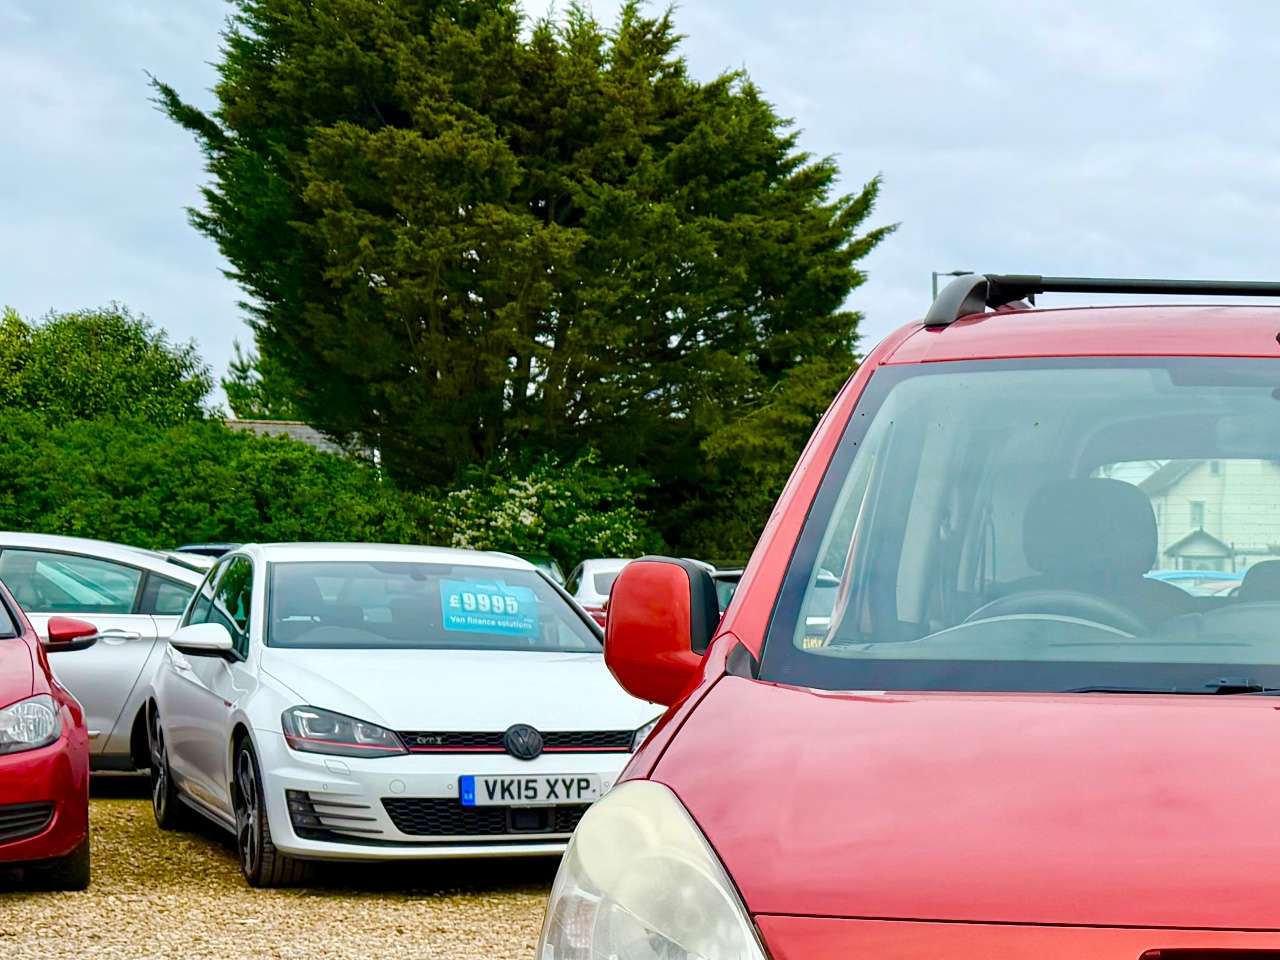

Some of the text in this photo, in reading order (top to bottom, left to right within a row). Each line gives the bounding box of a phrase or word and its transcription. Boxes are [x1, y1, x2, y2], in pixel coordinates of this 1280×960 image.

[450, 615, 532, 629] Van finance solutions
[484, 778, 590, 800] VK15 XYP
